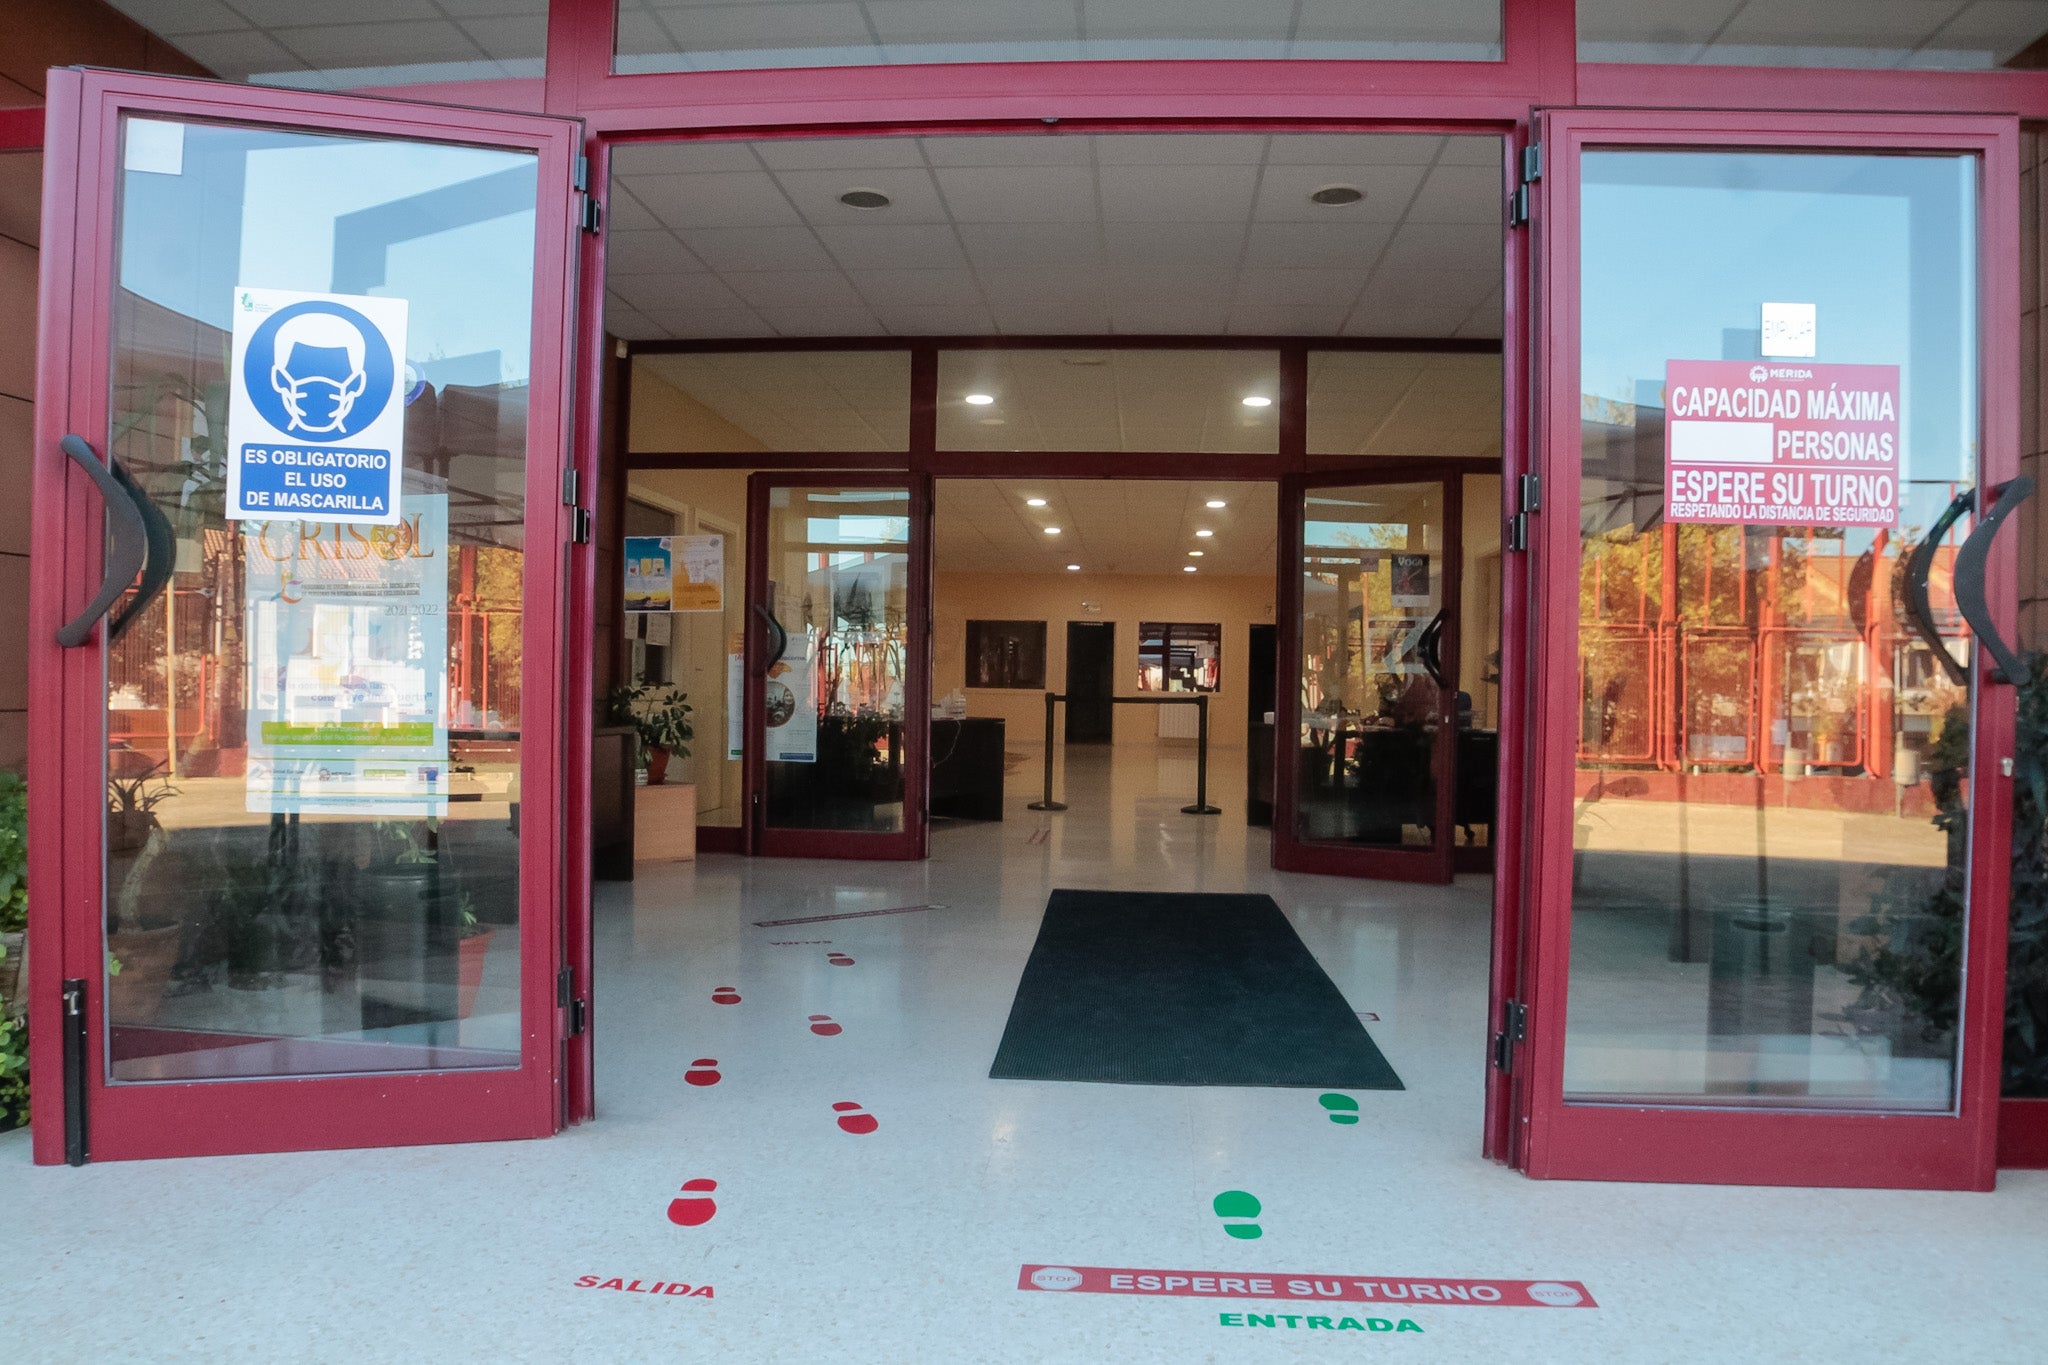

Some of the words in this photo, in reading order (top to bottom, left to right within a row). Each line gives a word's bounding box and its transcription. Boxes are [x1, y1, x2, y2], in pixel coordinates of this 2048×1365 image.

[1672, 386, 1801, 419] CAPACIDAD
[1807, 382, 1895, 421] MÁXIMA
[1777, 430, 1894, 461] PERSONAS
[245, 449, 267, 464] ES
[271, 450, 387, 470] OBLIGATORIO
[285, 472, 306, 487] EL
[311, 473, 347, 489] USO
[1672, 470, 1765, 504] ESPERE
[1772, 472, 1804, 506] SU
[1810, 473, 1893, 507] TURNO
[246, 491, 269, 506] DE
[274, 492, 384, 511] MASCARILLA
[1671, 504, 1741, 519] RESPETANDO
[1743, 505, 1757, 520] LA
[1758, 505, 1814, 521] DISTANCIA
[1816, 507, 1830, 521] DE
[1833, 507, 1894, 523] SEGURIDAD
[573, 1275, 714, 1298] SALIDA
[1110, 1274, 1275, 1295] ESPERE
[1287, 1280, 1342, 1296] SU
[1353, 1281, 1503, 1301] TURNO
[1533, 1290, 1576, 1298] STOP
[1219, 1313, 1425, 1333] ENTRADA
